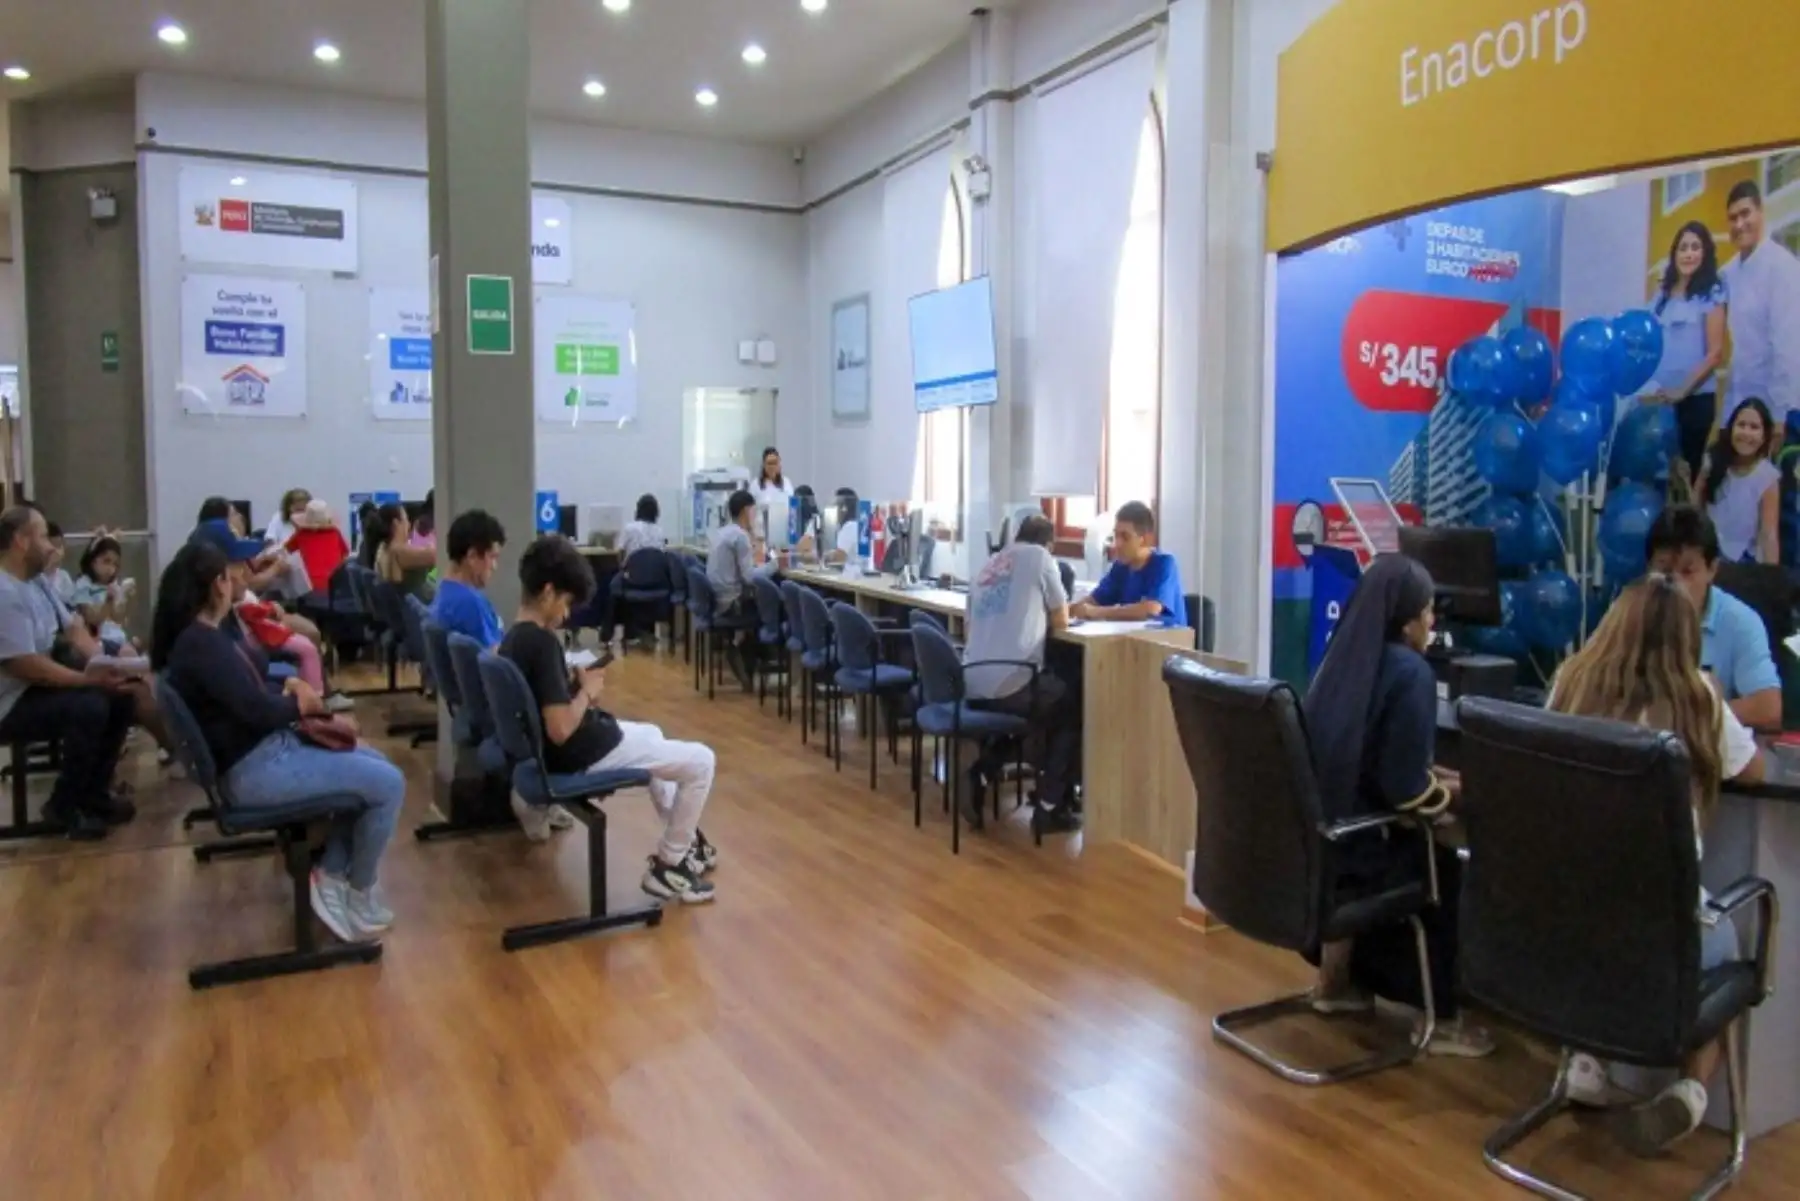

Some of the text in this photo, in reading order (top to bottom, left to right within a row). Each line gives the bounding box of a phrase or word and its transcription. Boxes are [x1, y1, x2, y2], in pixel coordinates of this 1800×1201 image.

[1402, 0, 1586, 107] Enacorp
[1426, 258, 1469, 278] SURCO
[472, 309, 507, 320] SALIDA
[1360, 340, 1379, 369] S/
[540, 499, 556, 522] 6
